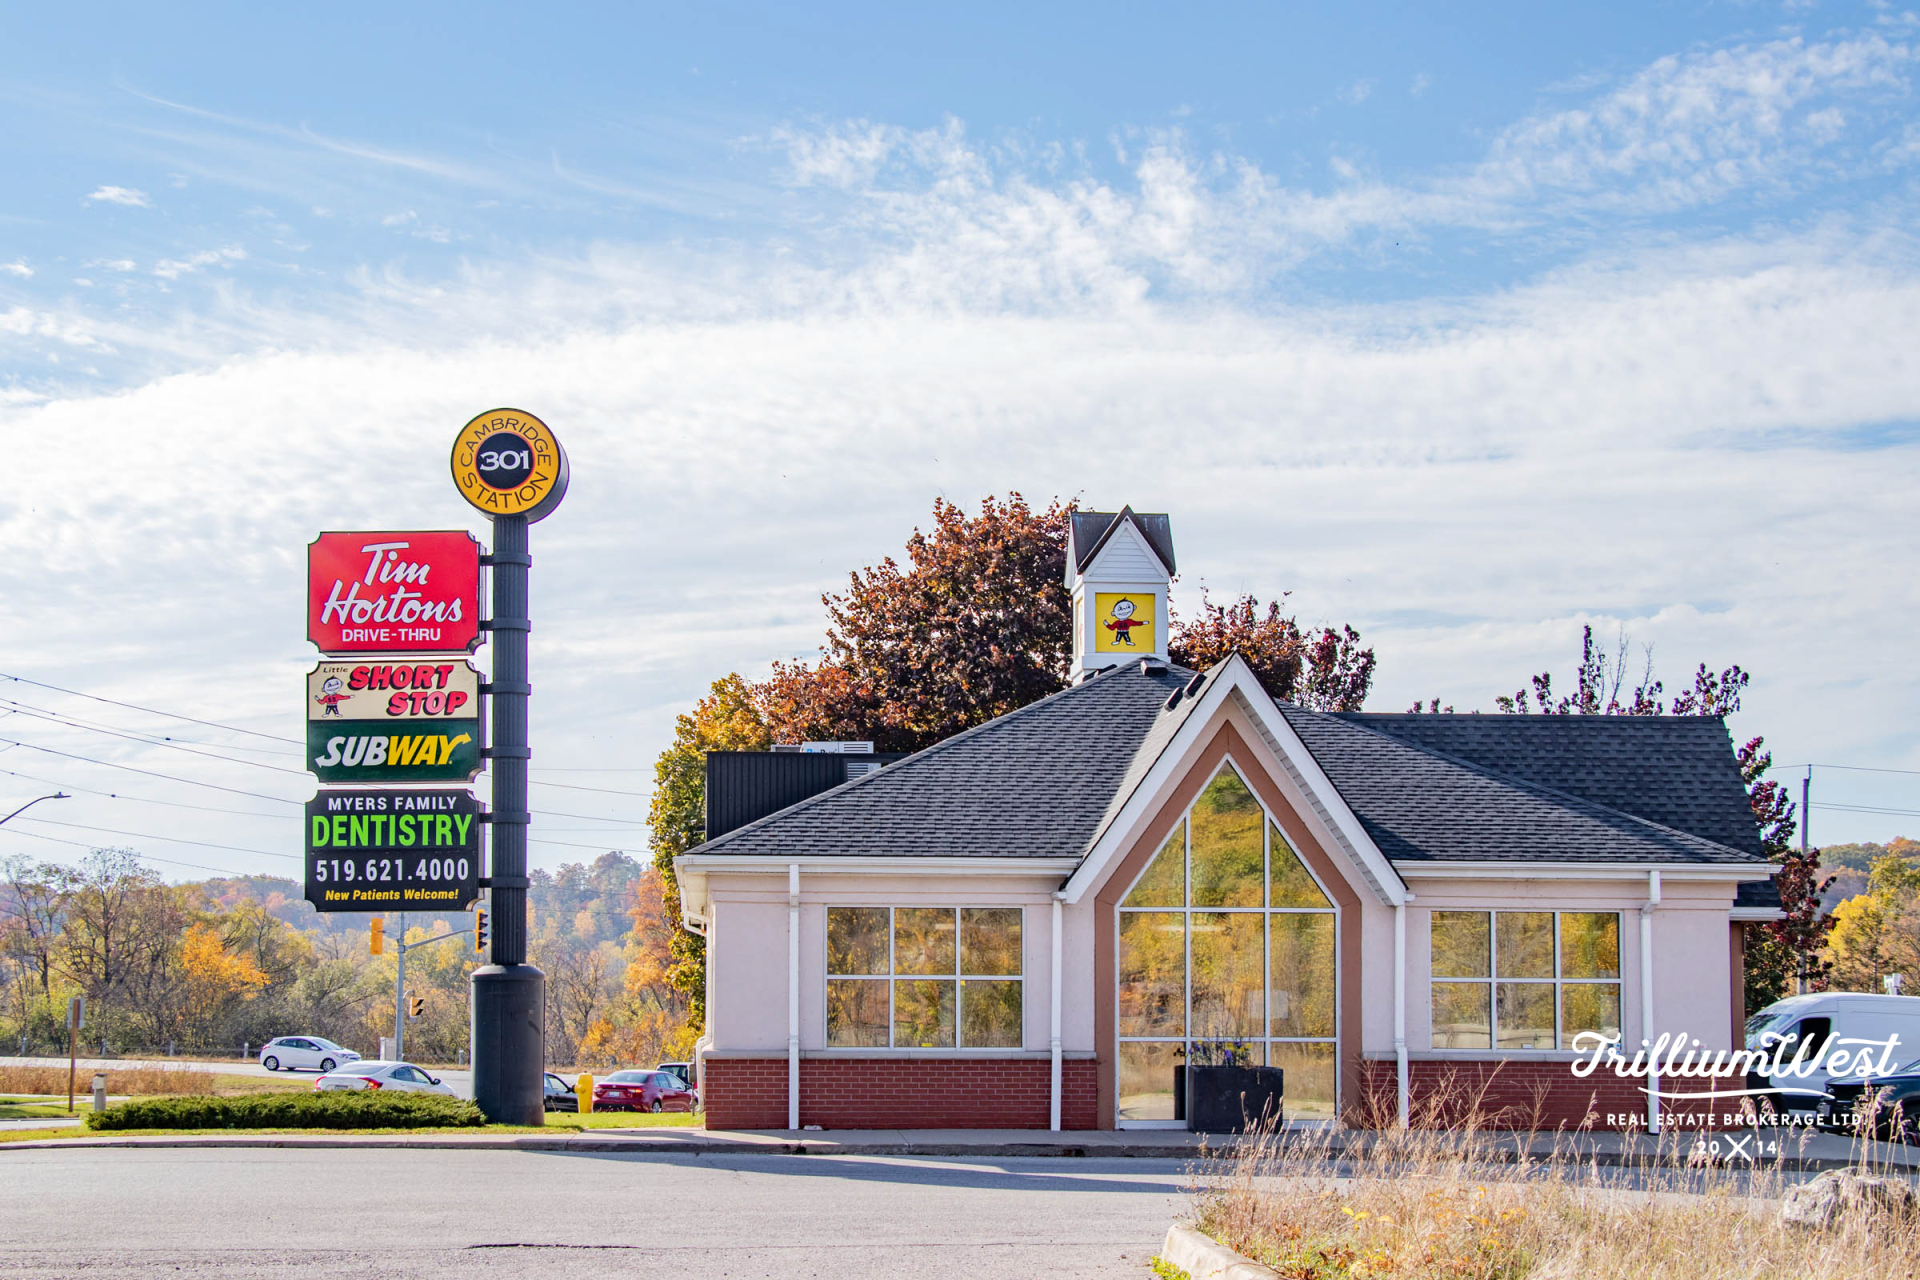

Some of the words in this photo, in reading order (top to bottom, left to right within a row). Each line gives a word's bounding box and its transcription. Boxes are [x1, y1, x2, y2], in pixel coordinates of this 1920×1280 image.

[460, 418, 551, 467] CAMBRIDGE
[479, 450, 530, 471] 301
[462, 471, 549, 508] STATION
[361, 541, 431, 586] Tim
[320, 579, 462, 625] Hortons
[342, 628, 441, 642] DRIVE-THRU
[348, 665, 454, 691] SHORT
[386, 691, 468, 716] STOP
[314, 732, 473, 768] SUBWAY
[328, 797, 387, 811] MYERS
[395, 796, 457, 810] FAMILY
[312, 814, 473, 847] DENTISTRY
[315, 858, 469, 882] 519.621.4000
[325, 890, 351, 901] New
[353, 889, 401, 901] Patients
[404, 888, 459, 900] Welcome!
